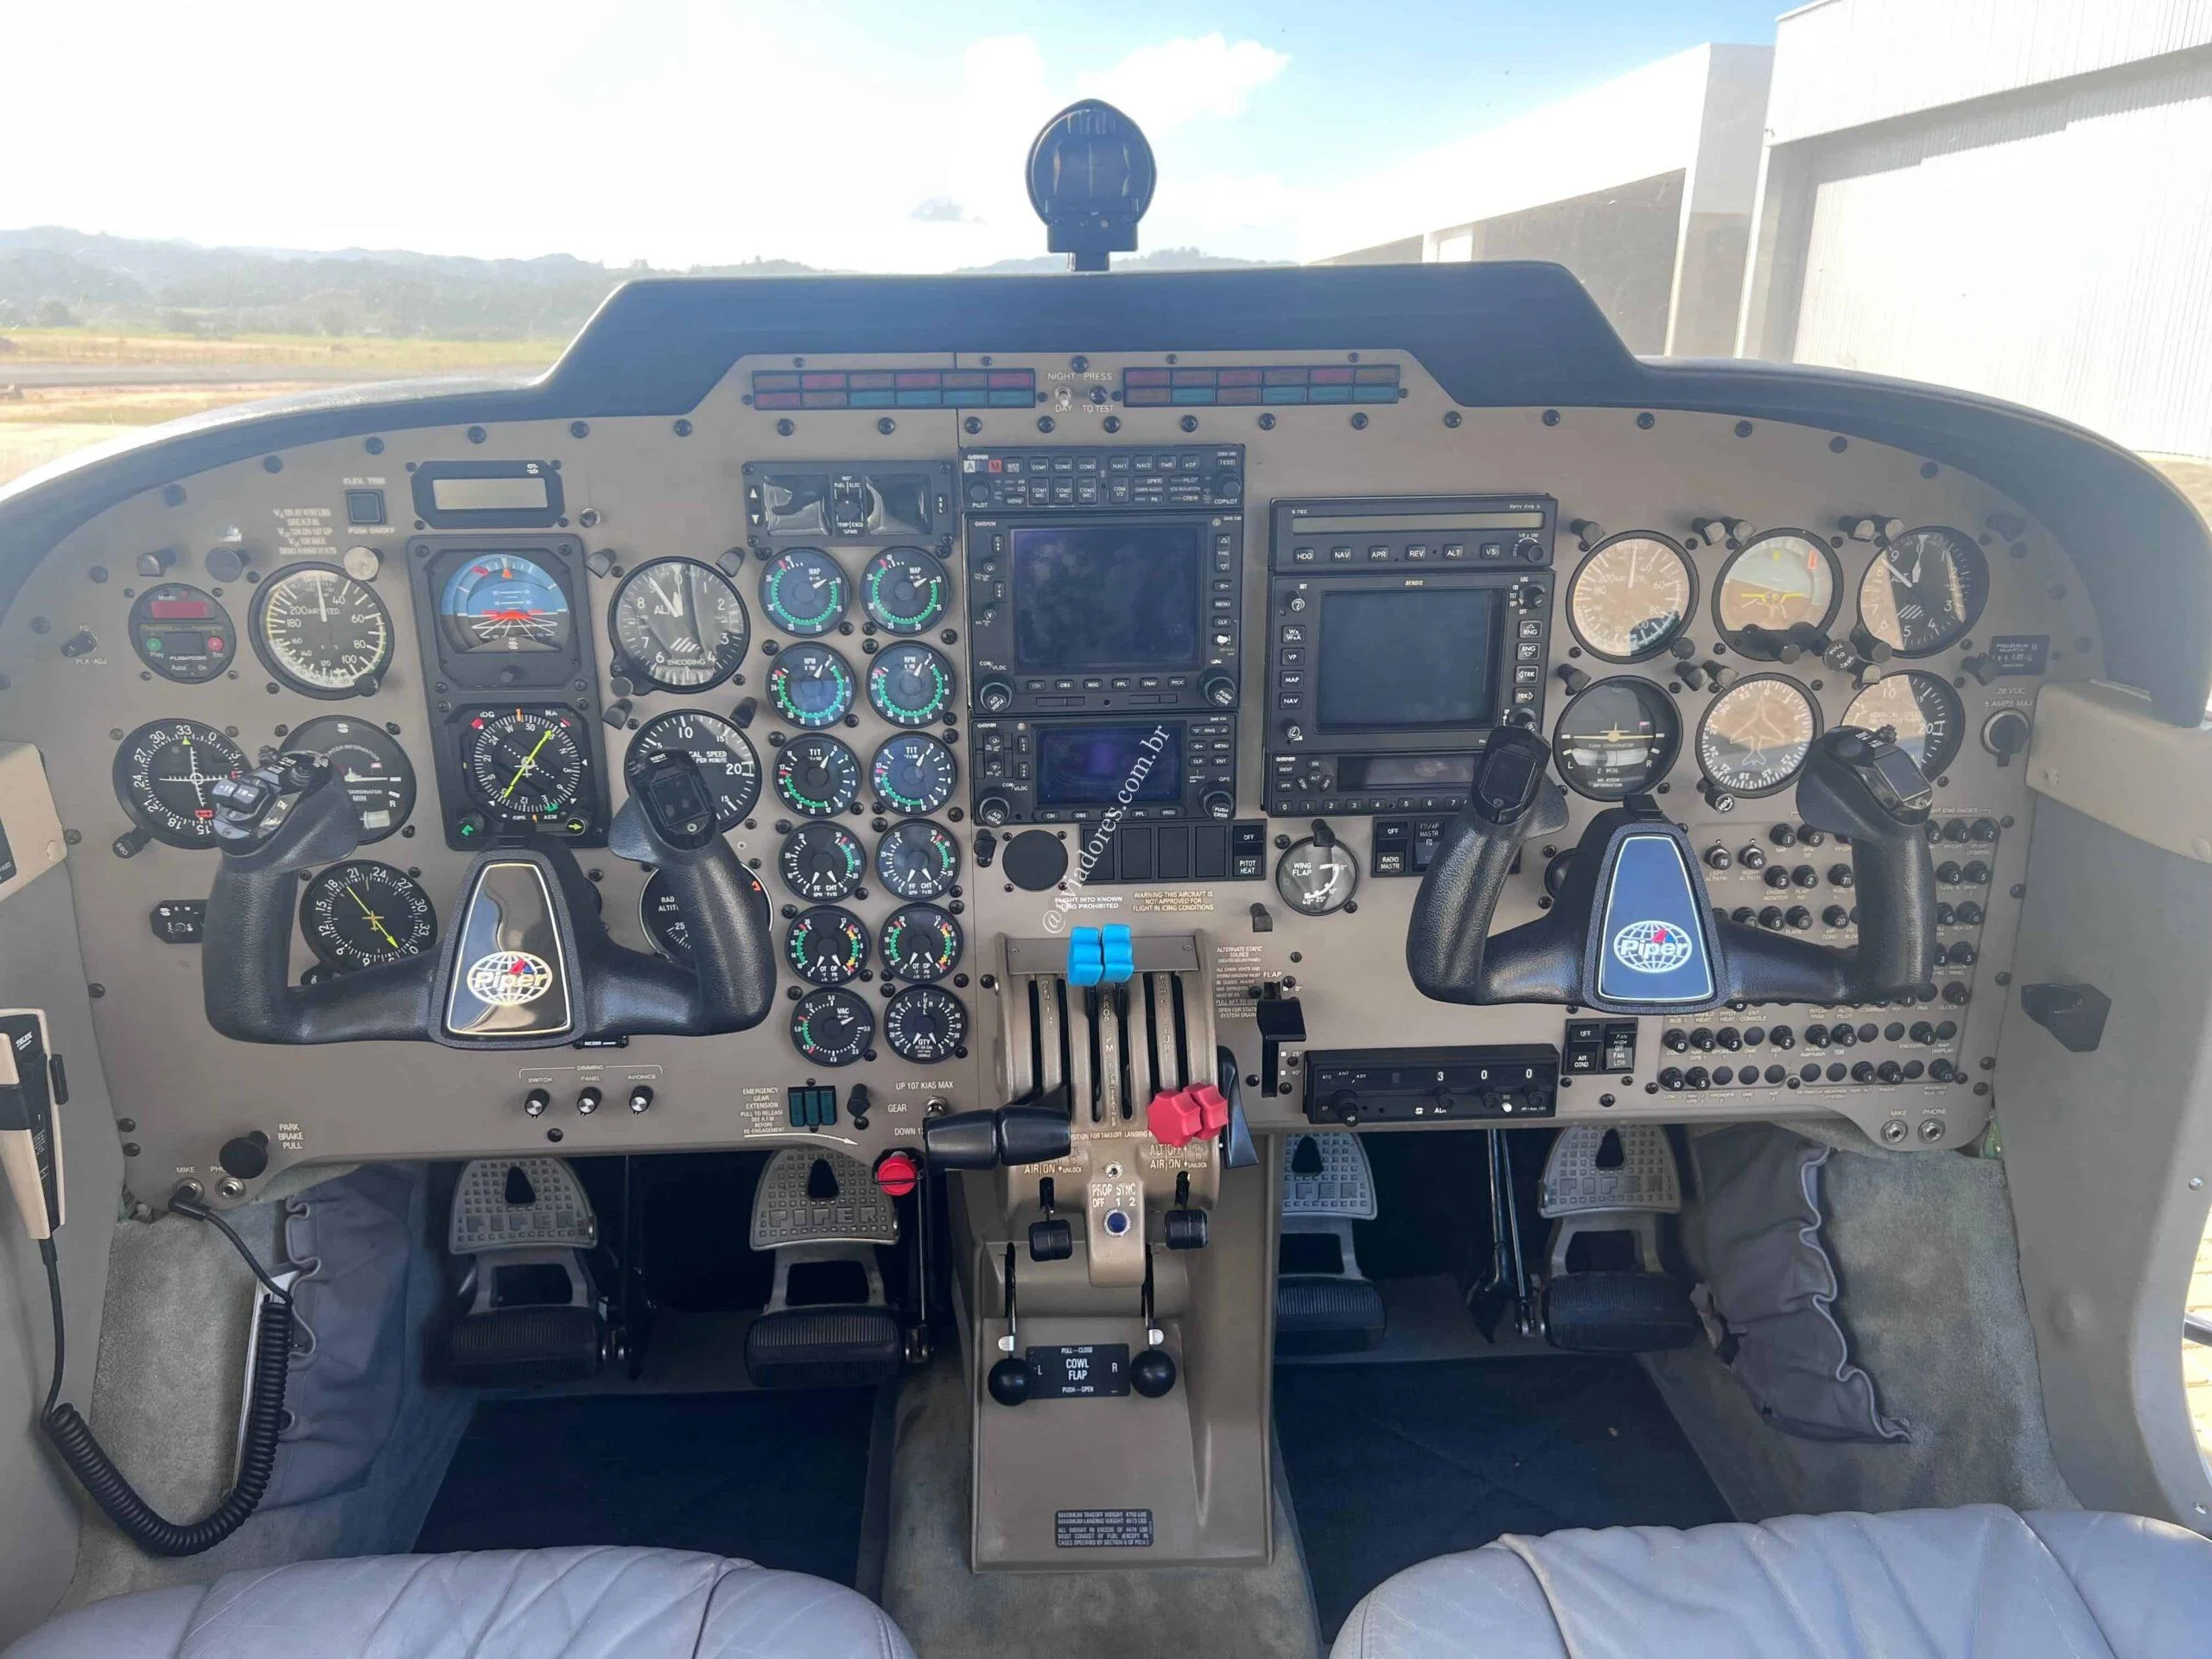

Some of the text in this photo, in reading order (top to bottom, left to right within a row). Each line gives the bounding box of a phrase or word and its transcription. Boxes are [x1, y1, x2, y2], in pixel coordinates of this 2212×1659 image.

[1055, 404, 1072, 413] DAY
[1083, 404, 1115, 413] TO TEST
[1891, 550, 1899, 562] 9
[333, 595, 345, 604] 40
[718, 599, 726, 610] 2
[287, 619, 301, 627] 180
[352, 614, 365, 623] 60
[1929, 619, 1936, 629] 4
[1904, 626, 1911, 637] 5
[721, 633, 728, 644] 3
[1829, 644, 1842, 655] PULL
[656, 652, 664, 663] 6
[709, 650, 716, 662] 4
[1840, 656, 1853, 668] CAGE
[176, 725, 192, 734] 33
[679, 727, 693, 738] 10
[149, 731, 165, 743] 30
[726, 764, 741, 774] 20
[133, 775, 144, 787] 24
[347, 868, 359, 878] 21
[373, 868, 386, 878] 24
[397, 879, 413, 889] 27
[675, 922, 685, 931] 25
[1621, 938, 1686, 960] Piper
[474, 971, 548, 991] Piper
[1437, 1069, 1532, 1081] 3 0 0
[1150, 1145, 1182, 1155] ALT OFF
[1150, 1159, 1180, 1168] AIR ON
[1025, 1165, 1055, 1173] AIR ON
[1092, 1183, 1136, 1196] PROP SYNC
[1092, 1198, 1104, 1207] OFF
[1116, 1198, 1121, 1206] 1
[1066, 1358, 1089, 1369] COWL
[1112, 1363, 1118, 1372] R
[1038, 1365, 1042, 1375] L
[1068, 1370, 1087, 1381] FLAP
